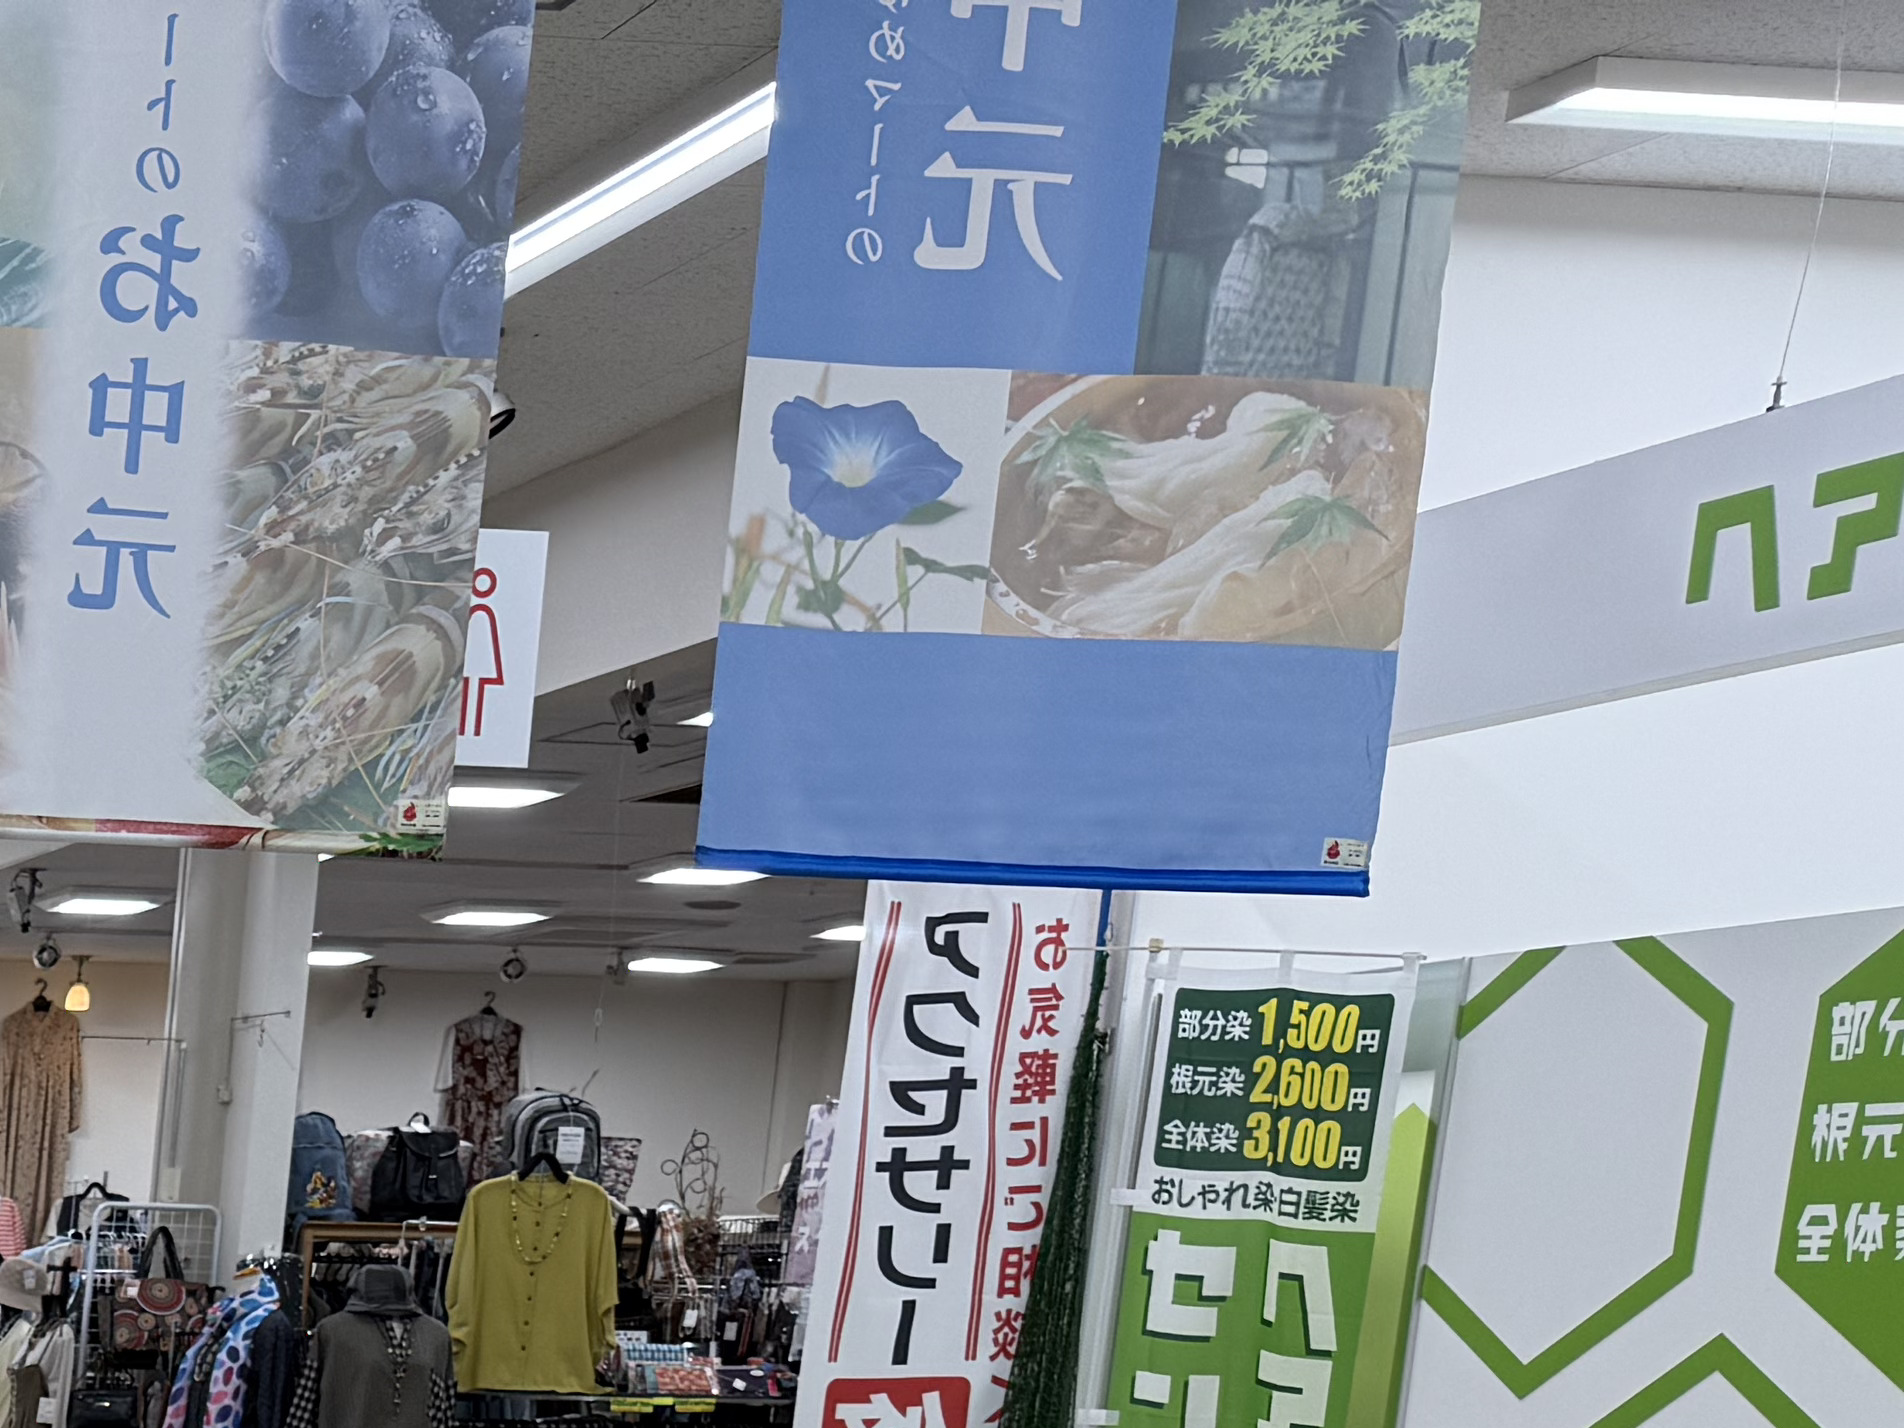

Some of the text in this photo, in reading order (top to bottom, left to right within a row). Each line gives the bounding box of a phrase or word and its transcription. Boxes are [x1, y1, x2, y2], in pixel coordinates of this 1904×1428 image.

[1177, 1009, 1252, 1041] 部分染
[1170, 1063, 1245, 1097] 根元染
[1161, 1119, 1239, 1153] 全体染
